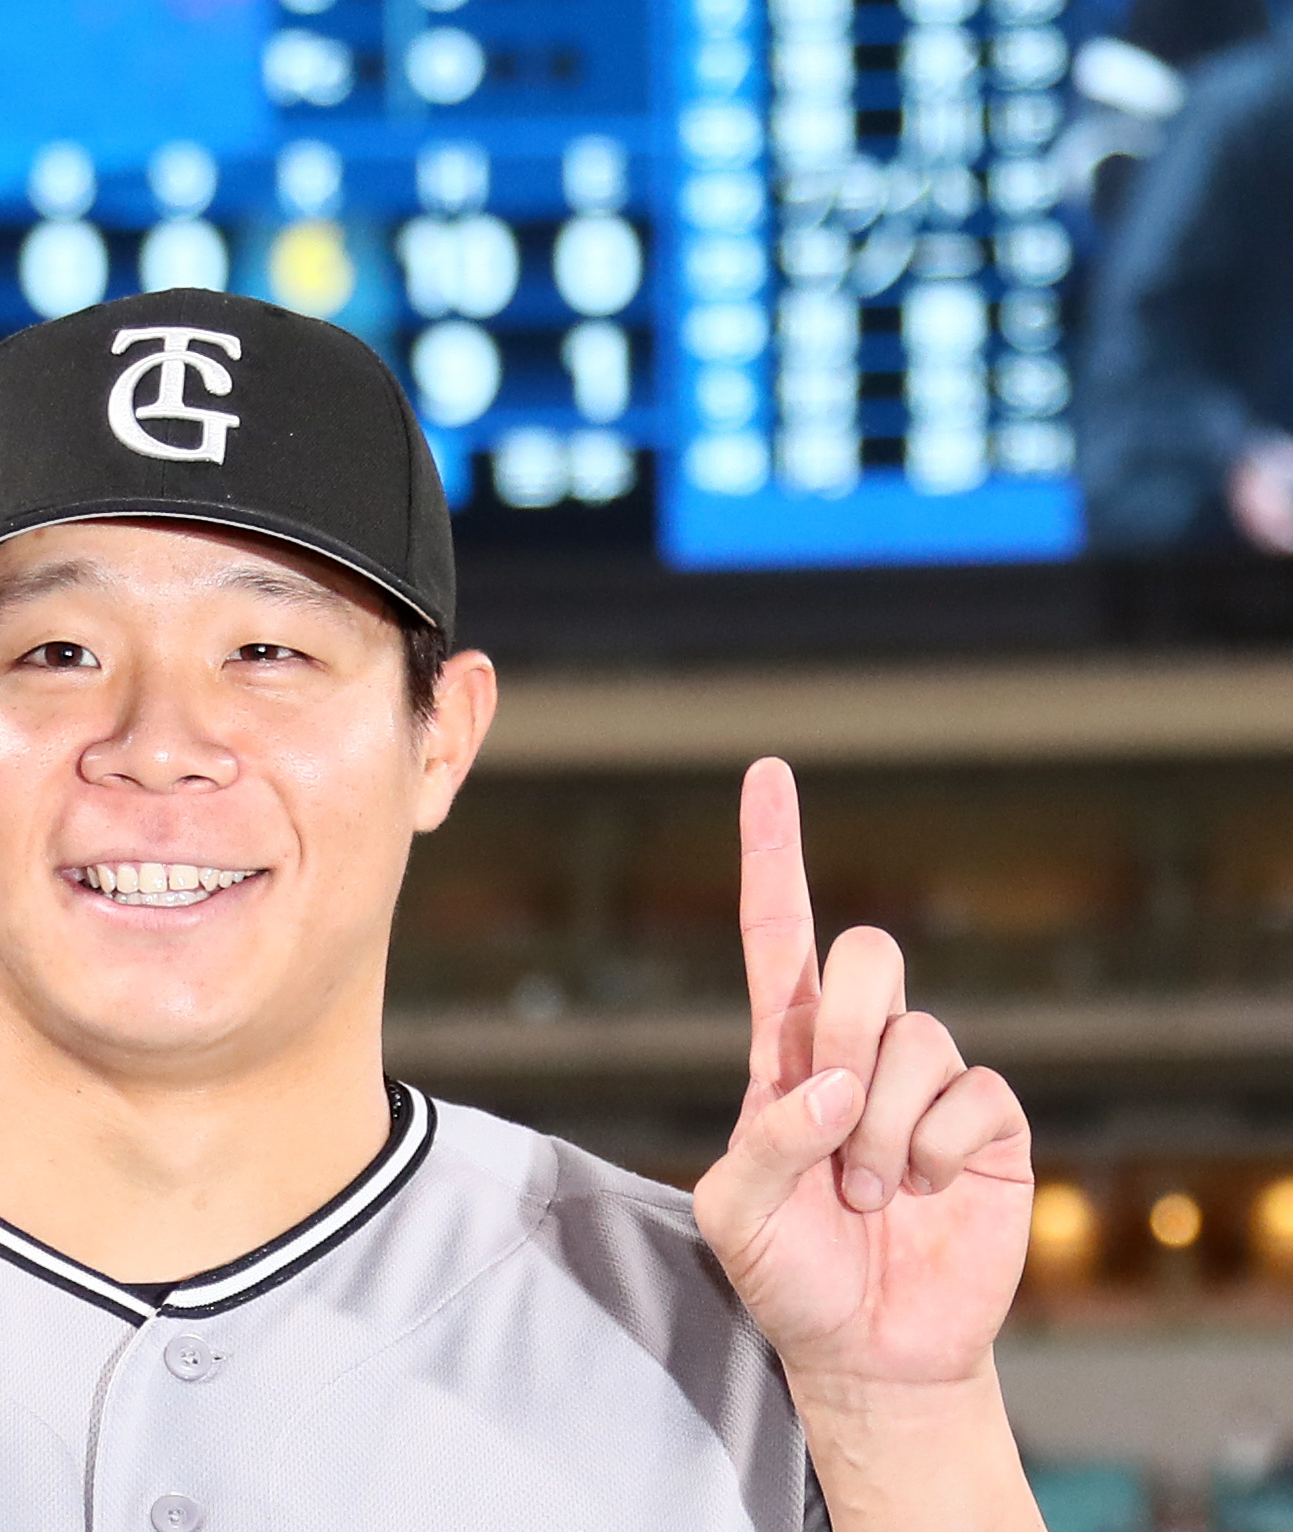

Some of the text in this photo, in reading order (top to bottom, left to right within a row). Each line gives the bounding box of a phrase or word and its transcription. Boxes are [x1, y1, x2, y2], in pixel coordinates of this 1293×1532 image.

[22, 218, 105, 318] 0
[403, 216, 516, 314] 10
[556, 213, 639, 313] 0
[567, 322, 627, 422] 1
